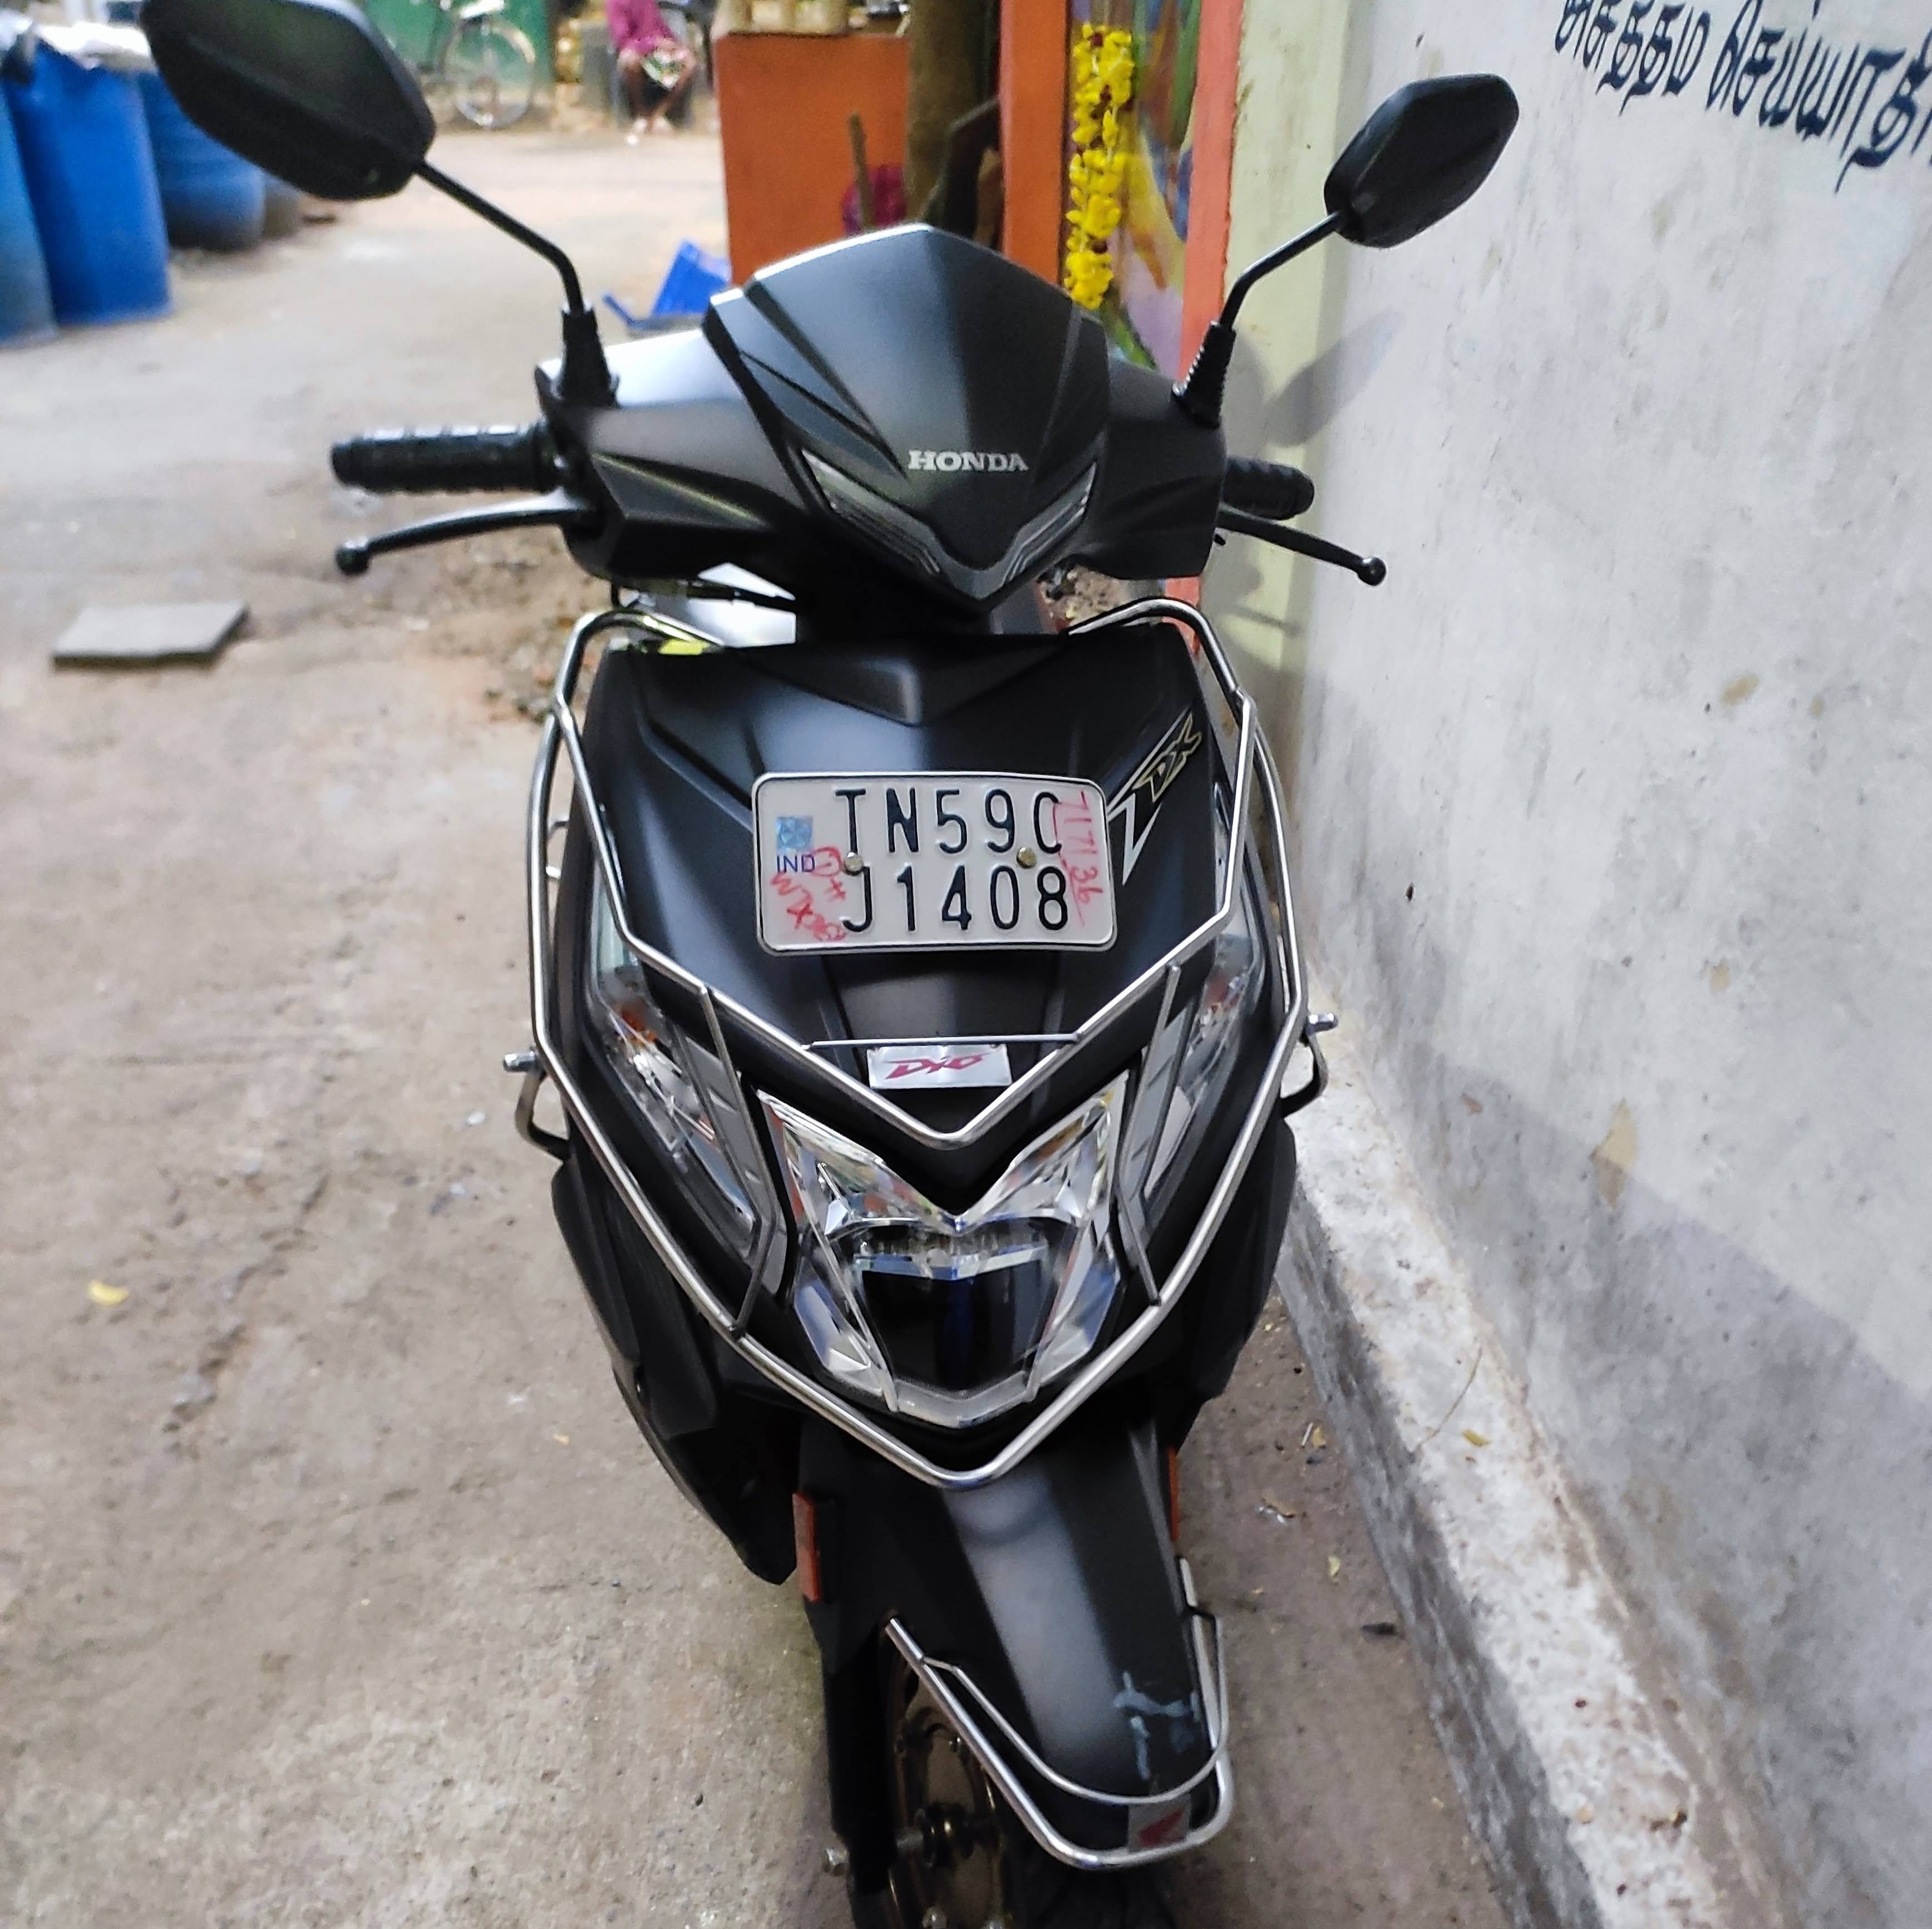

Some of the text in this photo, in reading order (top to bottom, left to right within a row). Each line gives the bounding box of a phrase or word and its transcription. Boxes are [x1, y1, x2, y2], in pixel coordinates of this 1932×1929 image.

[908, 450, 1029, 472] HONDA
[776, 854, 815, 873] IND
[841, 865, 1068, 931] J1408
